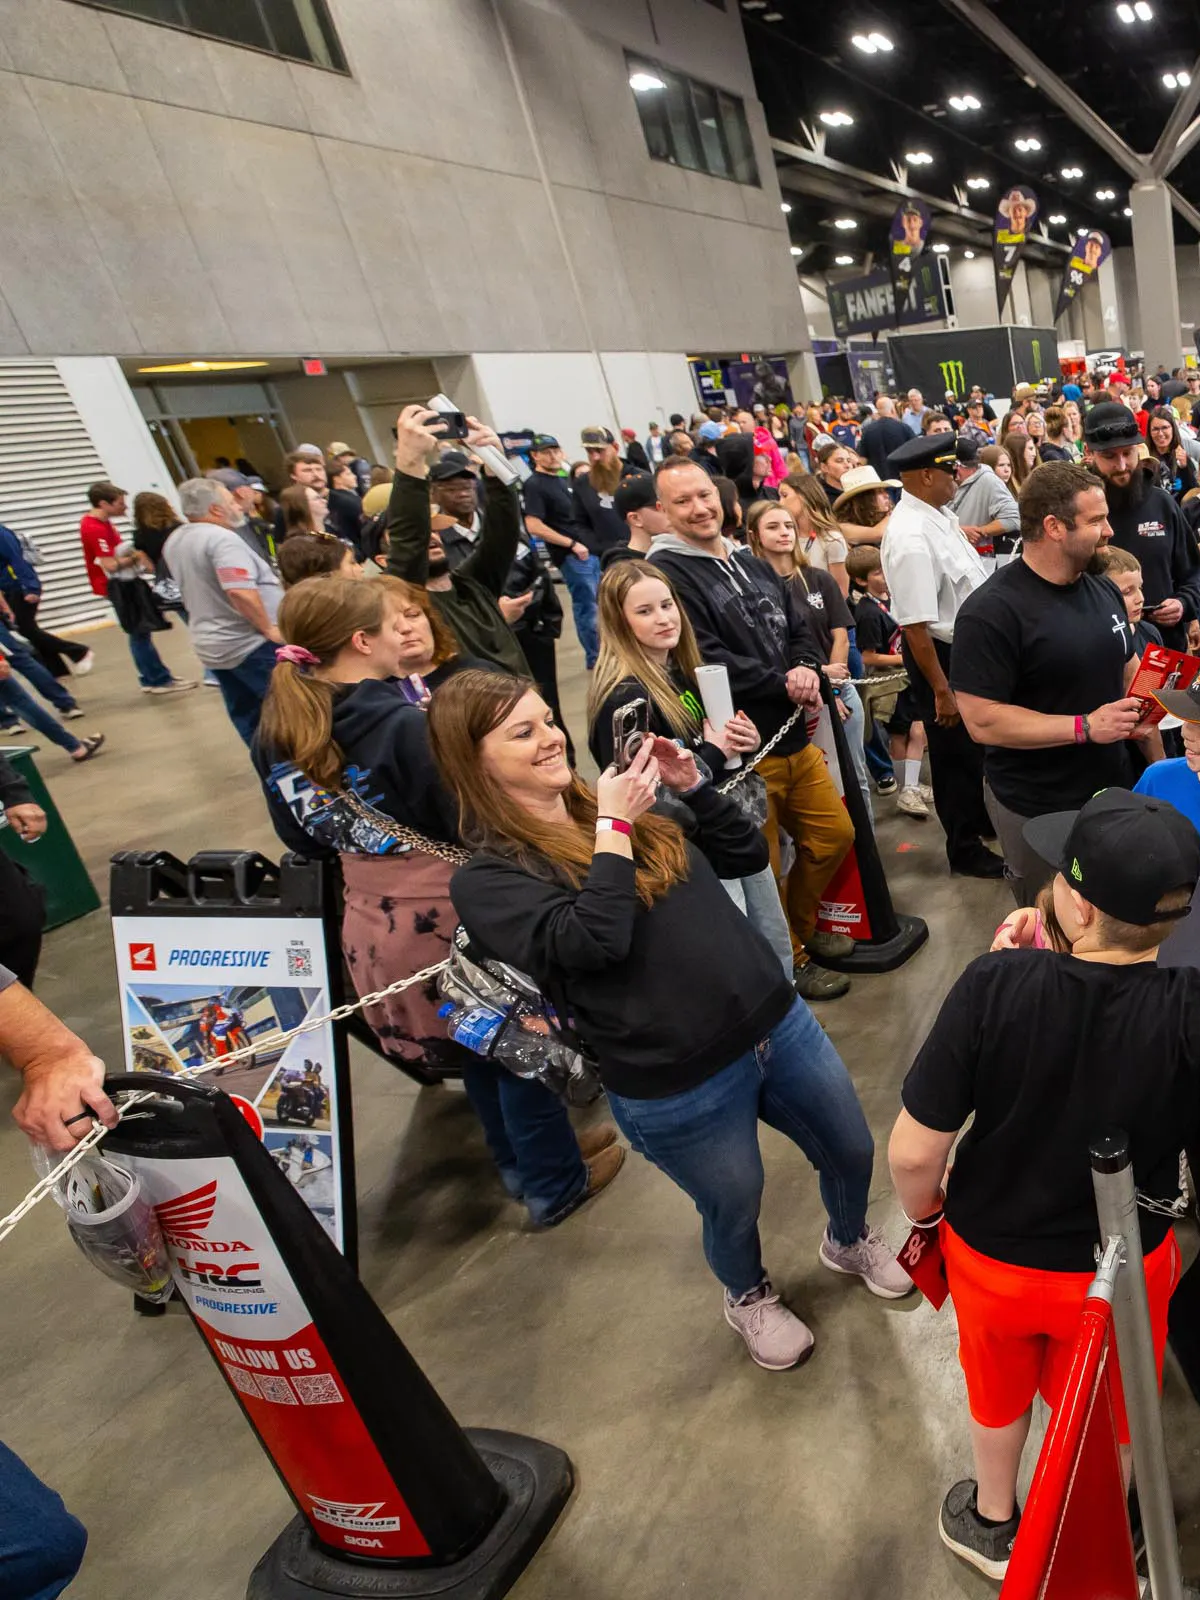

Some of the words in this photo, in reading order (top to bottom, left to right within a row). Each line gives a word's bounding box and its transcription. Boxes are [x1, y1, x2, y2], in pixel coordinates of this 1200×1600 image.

[1003, 246, 1017, 262] 7
[898, 256, 911, 272] 4
[1070, 270, 1084, 285] 96
[845, 277, 918, 322] FANFET
[168, 949, 271, 968] PROGRESSIVE
[168, 1237, 254, 1253] HONDA
[176, 1257, 261, 1287] HRC
[195, 1295, 279, 1315] PROGRESSIVE
[214, 1338, 280, 1371] FOLLOW
[282, 1348, 317, 1370] US
